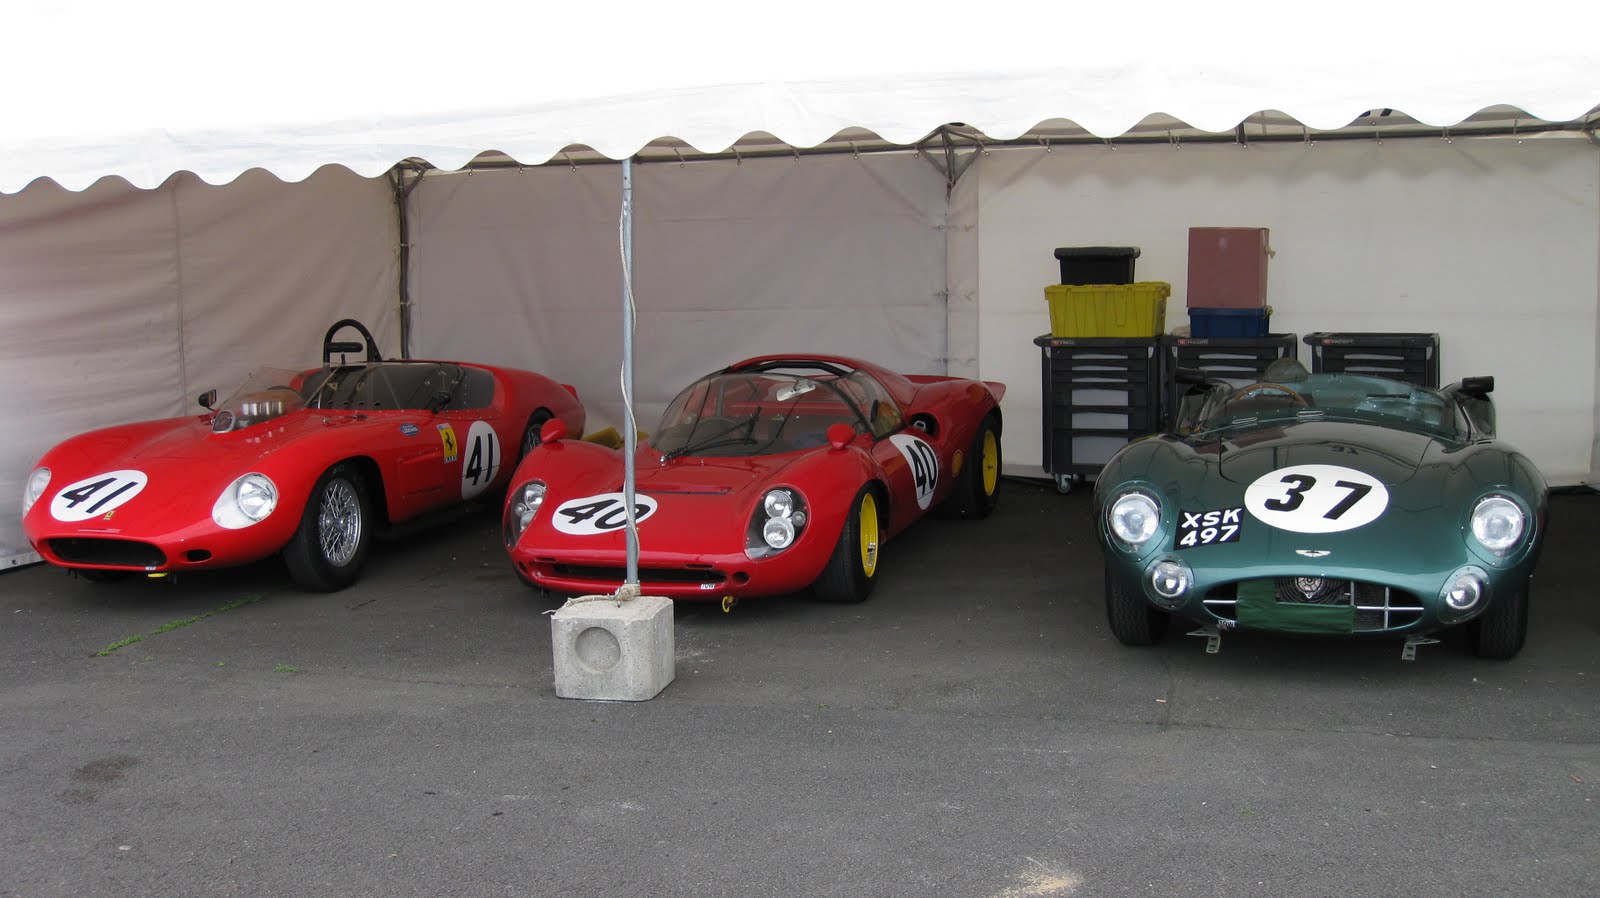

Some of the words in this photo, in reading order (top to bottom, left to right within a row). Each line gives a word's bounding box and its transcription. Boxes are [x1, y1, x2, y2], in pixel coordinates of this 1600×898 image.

[465, 433, 494, 486] 41
[905, 439, 938, 496] 40
[61, 477, 139, 514] 41
[558, 498, 651, 530] 40
[1264, 473, 1373, 520] 37
[1179, 524, 1239, 547] 497
[1181, 508, 1242, 528] XSK
